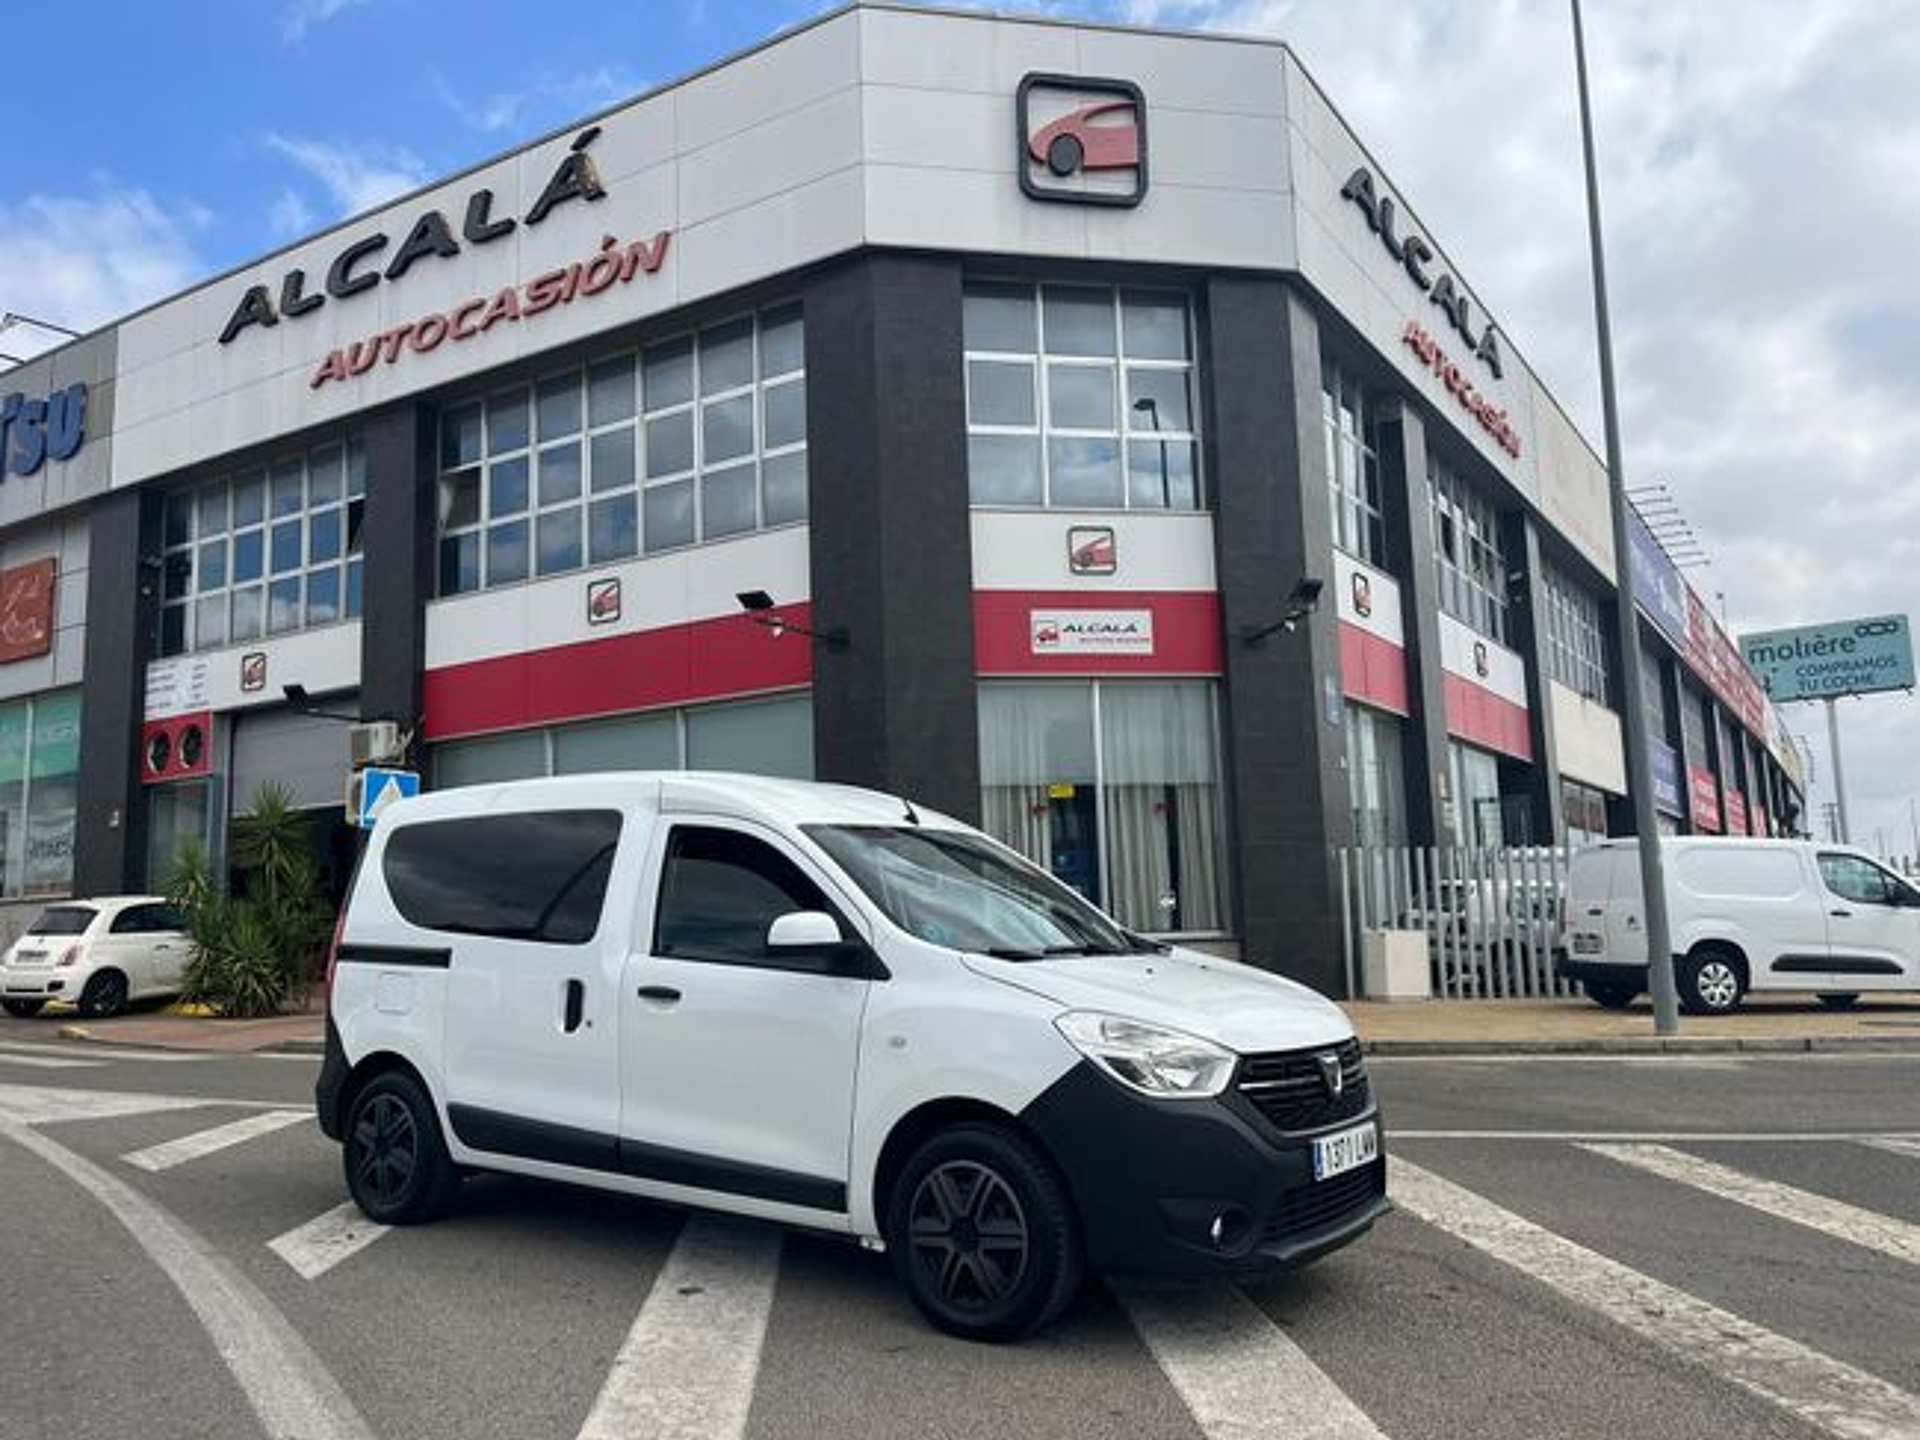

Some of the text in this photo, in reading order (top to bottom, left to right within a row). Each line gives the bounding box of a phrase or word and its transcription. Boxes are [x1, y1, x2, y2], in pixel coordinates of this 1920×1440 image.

[218, 126, 607, 344] ALCALÁ
[310, 231, 672, 390] AUTOCASIÓN
[1341, 167, 1503, 379] ALCALÁ
[1795, 655, 1899, 677] COMPRAMOS
[1796, 673, 1876, 692] TU COCHE
